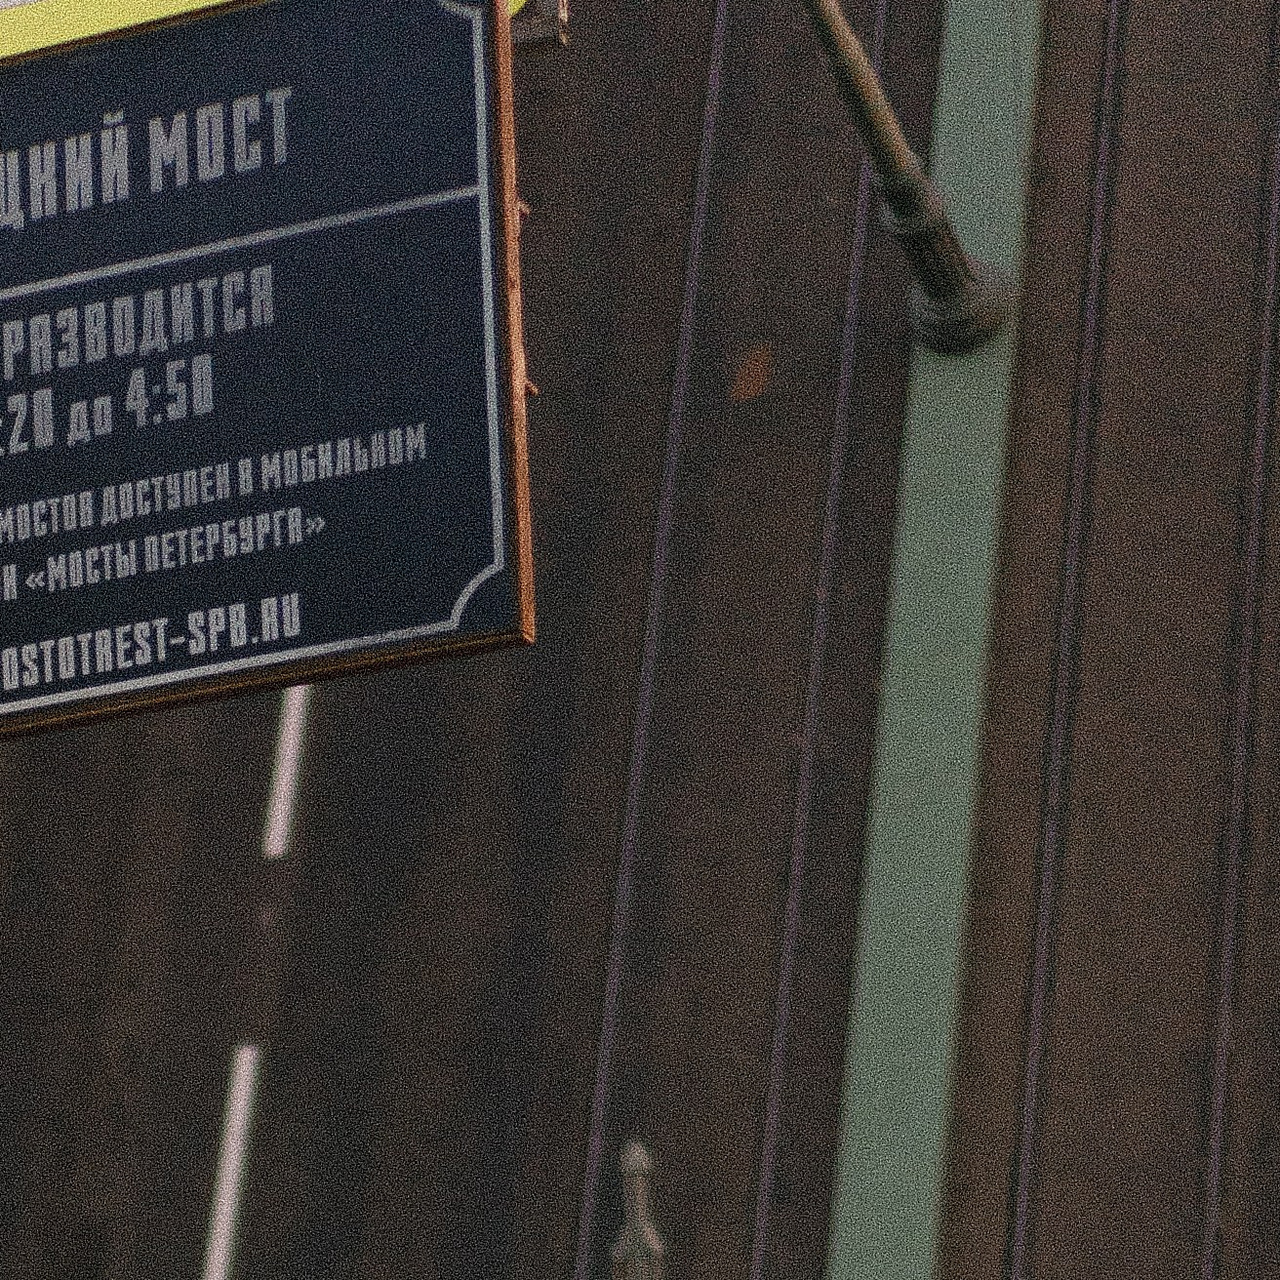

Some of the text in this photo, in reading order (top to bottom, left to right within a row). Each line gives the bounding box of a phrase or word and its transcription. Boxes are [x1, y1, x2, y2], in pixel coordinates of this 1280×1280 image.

[148, 87, 293, 193] МОСТ
[3, 265, 274, 379] РАЗВОДИТСЯ
[125, 354, 213, 428] 4:50
[100, 462, 230, 527] ДОСТУПЕН
[238, 458, 255, 497] В
[261, 423, 426, 491] МОБИЛЬНОМ
[25, 539, 136, 593] «МОСТЫ
[144, 506, 326, 572] ПЕТЕРБУРГА»
